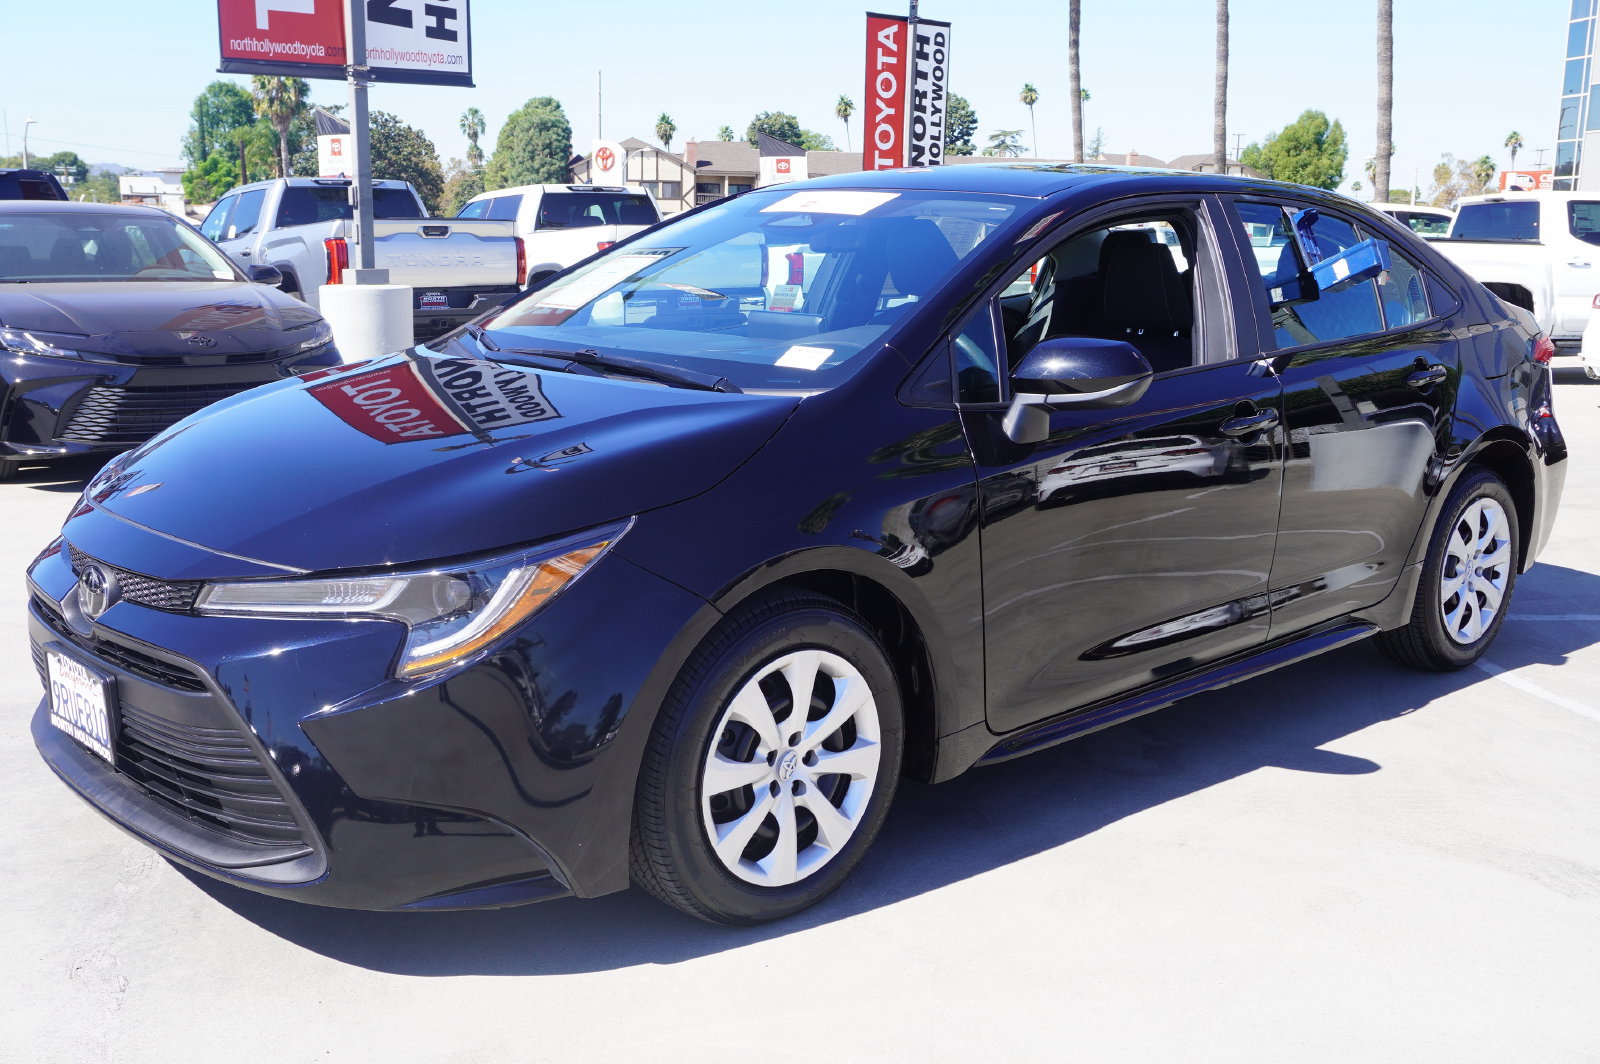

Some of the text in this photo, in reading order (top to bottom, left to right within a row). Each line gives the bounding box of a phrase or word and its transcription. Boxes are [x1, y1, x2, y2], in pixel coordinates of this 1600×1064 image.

[230, 37, 346, 58] northhollywoodtoyota.com
[365, 47, 463, 66] orthhollywoodtoyota.com
[874, 24, 899, 170] TOYOTA
[911, 33, 931, 167] NORTH
[51, 713, 112, 762] NORTH HOLLYWOOD
